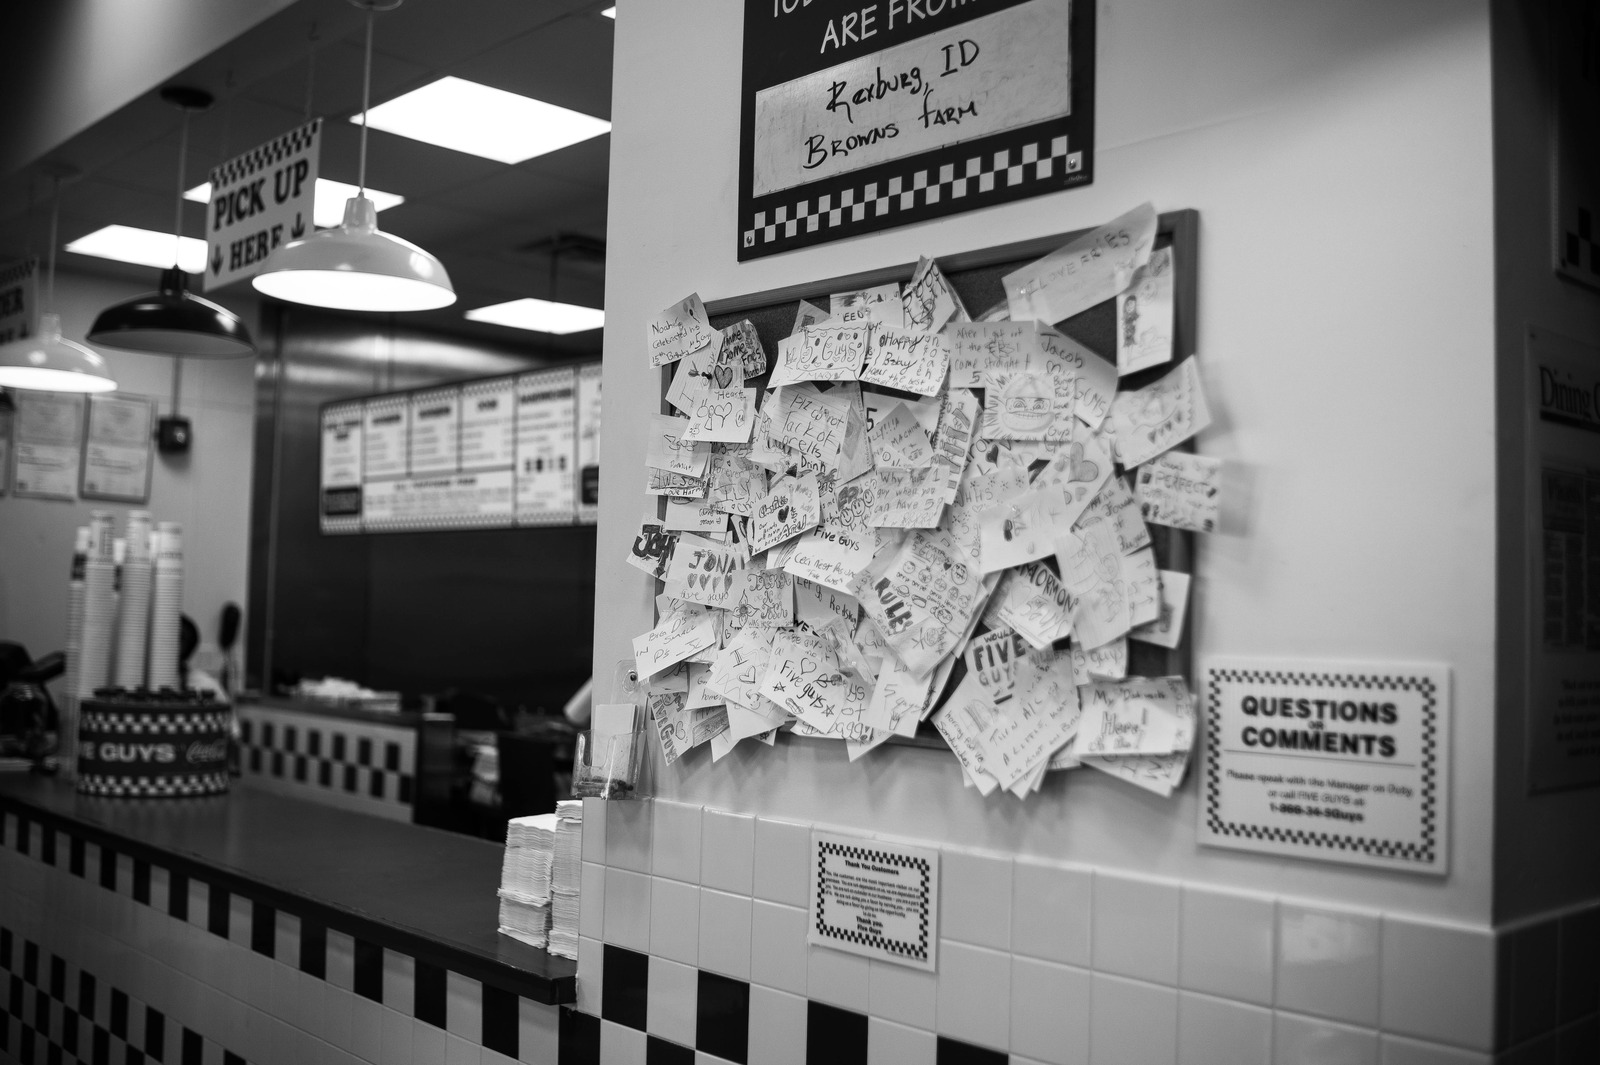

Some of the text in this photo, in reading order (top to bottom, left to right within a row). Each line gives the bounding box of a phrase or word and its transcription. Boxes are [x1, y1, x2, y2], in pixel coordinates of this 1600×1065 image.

[820, 5, 878, 54] ARE
[888, 0, 978, 30] FRO
[940, 39, 980, 78] ID
[213, 157, 309, 232] PICK UP
[884, 331, 926, 354] Happy
[866, 406, 879, 433] 5
[814, 525, 836, 543] Five
[972, 633, 1027, 673] FIVE
[780, 659, 804, 688] Five
[796, 682, 828, 709] guys
[1241, 694, 1398, 725] QUESTIONS
[99, 742, 177, 763] GUYS
[1241, 726, 1397, 758] COMMENTS
[1226, 769, 1256, 782] Please
[1256, 773, 1284, 787] speak
[1286, 774, 1306, 785] with
[1308, 775, 1325, 787] the
[1326, 777, 1370, 795] Manager
[1372, 784, 1386, 793] on
[1267, 789, 1278, 798] or
[1279, 788, 1296, 799] call
[1297, 790, 1320, 802] FIVE
[1321, 792, 1352, 805] GUYS
[845, 859, 860, 869] Thank
[861, 862, 871, 871] You
[856, 916, 873, 926] Thank
[857, 924, 882, 936] Five Guys
